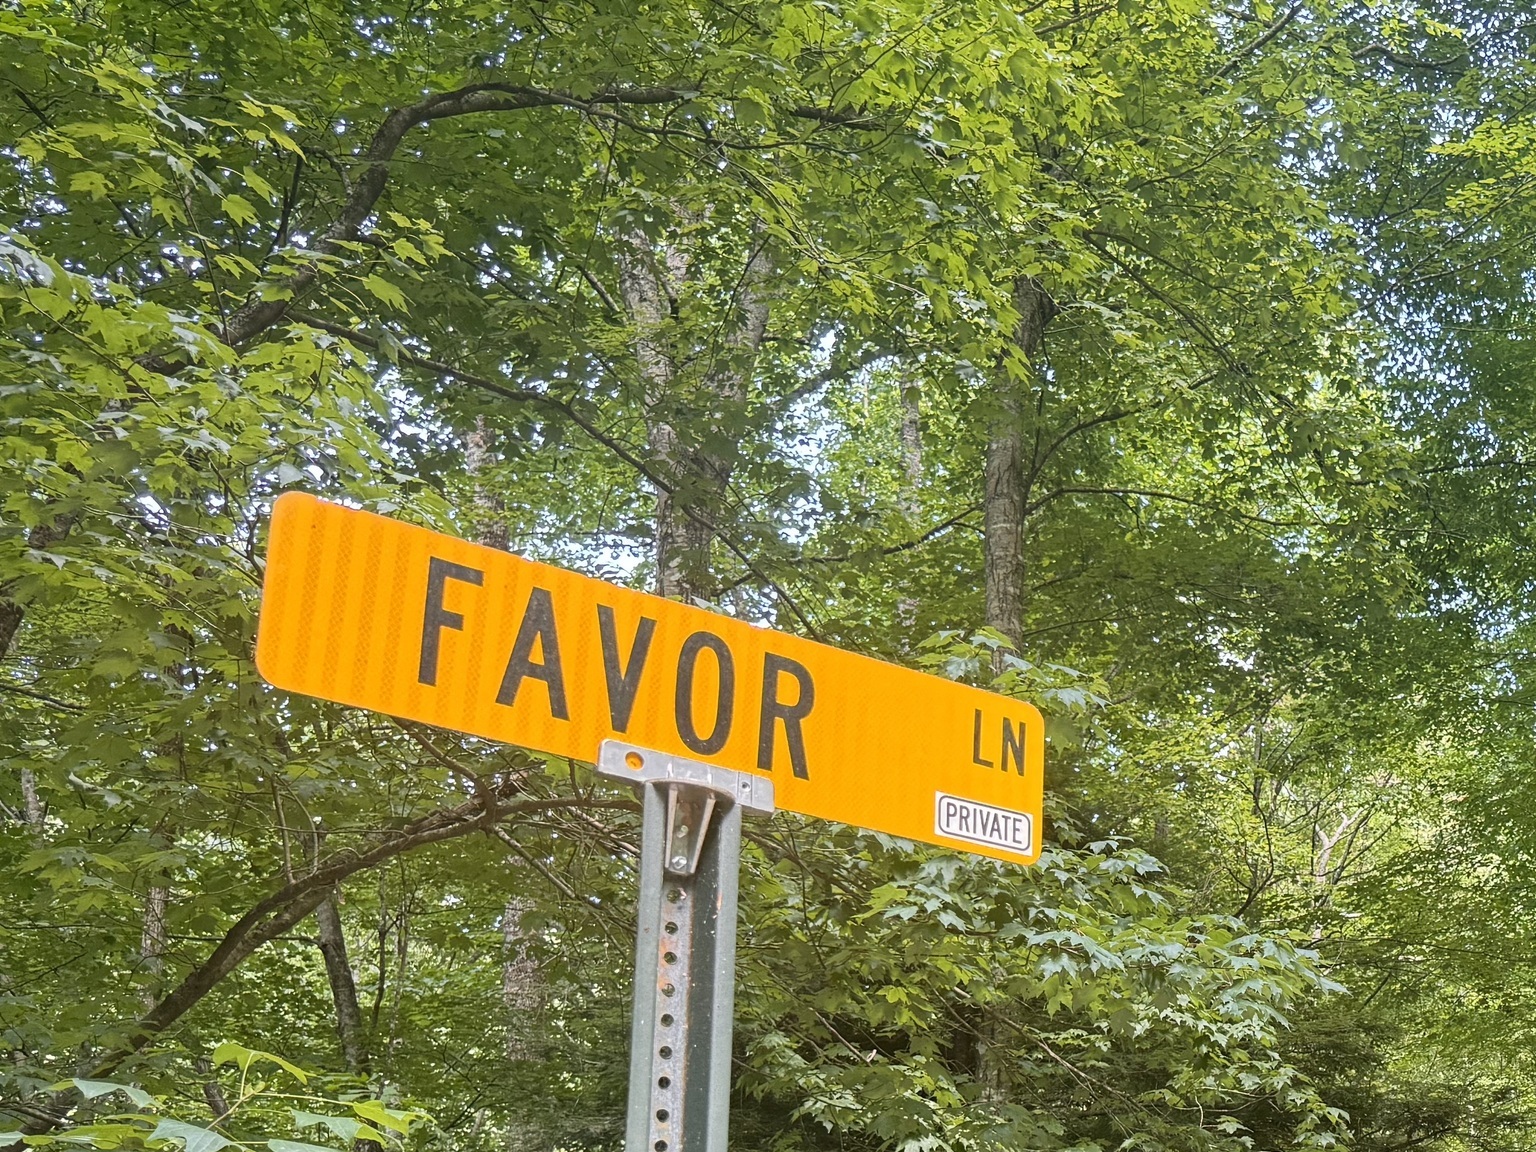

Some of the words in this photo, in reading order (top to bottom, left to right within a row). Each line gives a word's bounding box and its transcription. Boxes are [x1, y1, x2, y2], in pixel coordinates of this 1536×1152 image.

[418, 556, 815, 780] FAVOR
[972, 709, 1026, 777] LN
[946, 801, 1023, 844] PRIVATE
